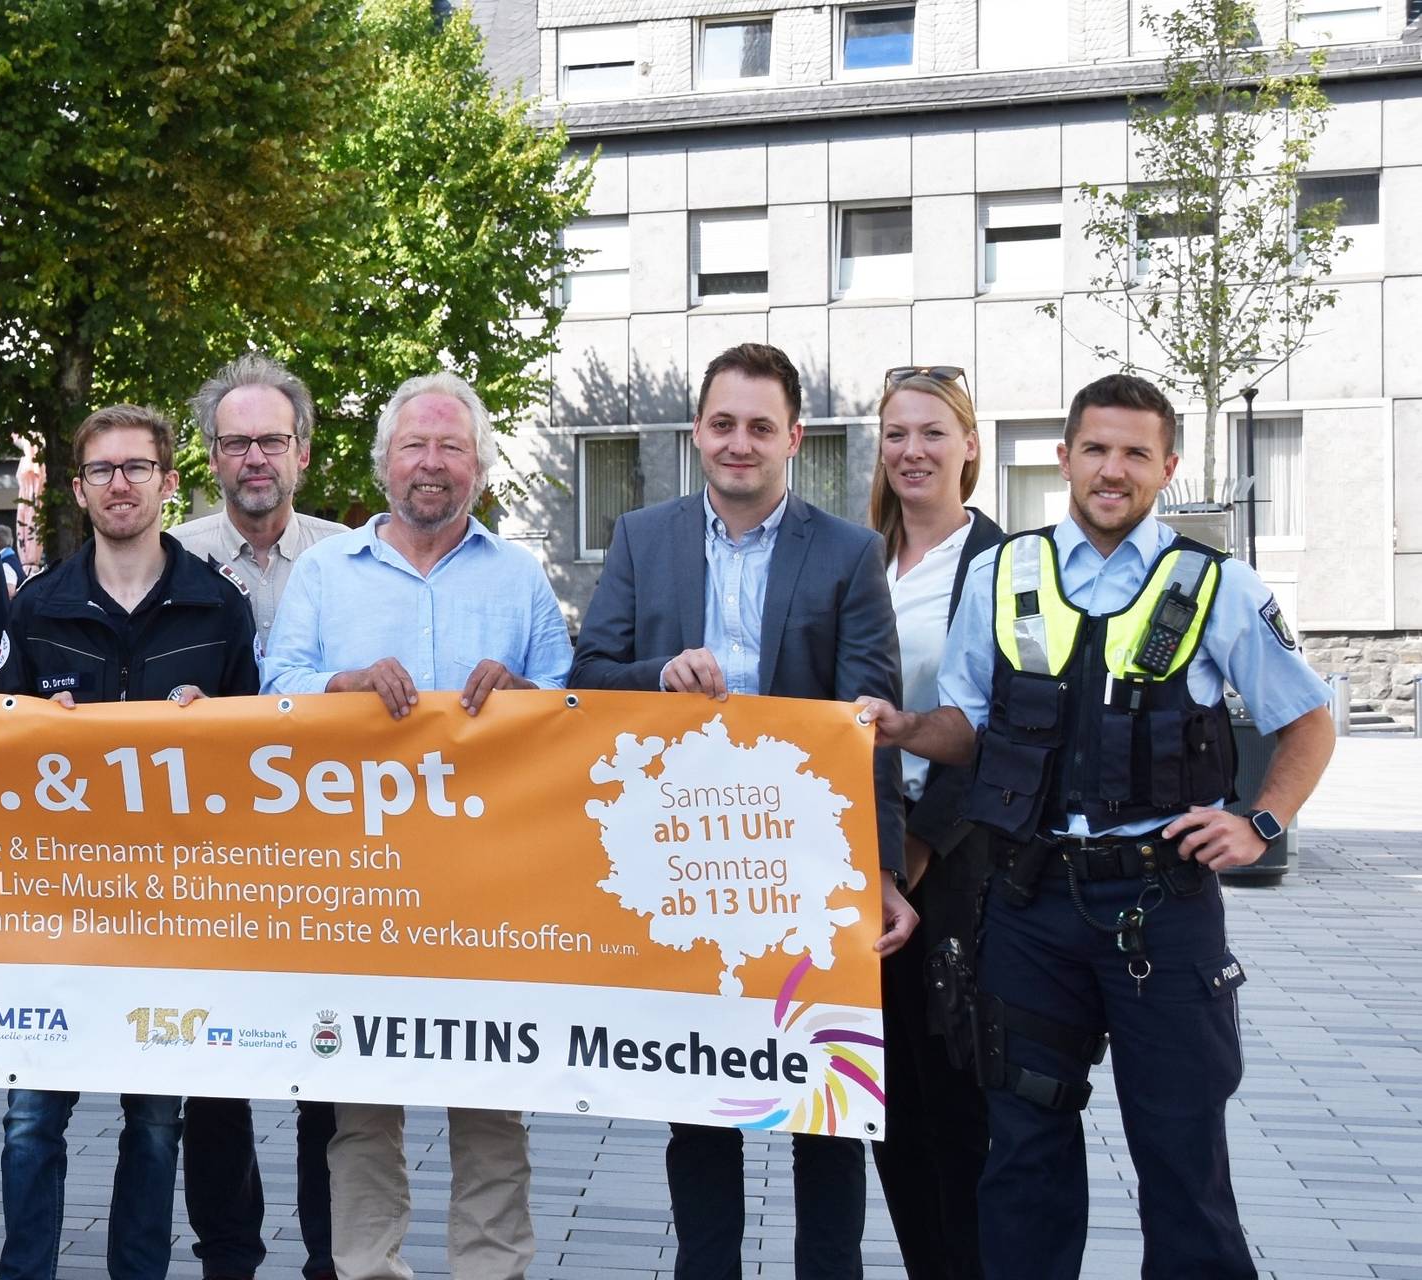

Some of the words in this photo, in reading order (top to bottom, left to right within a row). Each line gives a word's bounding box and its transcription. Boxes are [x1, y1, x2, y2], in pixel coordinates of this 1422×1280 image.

[34, 752, 92, 812] &
[103, 746, 227, 814] 11.
[249, 744, 485, 836] Sept.
[659, 781, 781, 812] Samstag
[654, 816, 690, 843] ab
[699, 814, 730, 841] 11
[741, 811, 795, 840] Uhr
[9, 838, 29, 861] &
[36, 836, 164, 865] Ehrenamt
[173, 841, 343, 871] präsentieren
[349, 842, 402, 870] sich
[667, 855, 788, 886] Sonntag
[145, 877, 165, 901] &
[172, 876, 421, 913] Bühnenprogramm
[661, 889, 696, 916] ab
[705, 888, 739, 915] 13
[746, 886, 801, 914] Uhr
[72, 907, 260, 941] Blaulichtmeile
[268, 912, 291, 940] in
[300, 915, 372, 944] Enste
[379, 919, 400, 944] &
[406, 920, 592, 953] verkaufsoffen
[599, 941, 640, 957] u.v.m.
[24, 1032, 40, 1041] seit
[44, 1033, 68, 1042] 1679
[125, 1007, 210, 1045] 150
[238, 1028, 288, 1039] Volksbank
[352, 1015, 540, 1064] VELTINS
[238, 1038, 284, 1049] Sauerland
[284, 1041, 298, 1049] eG
[566, 1024, 809, 1085] Meschede
